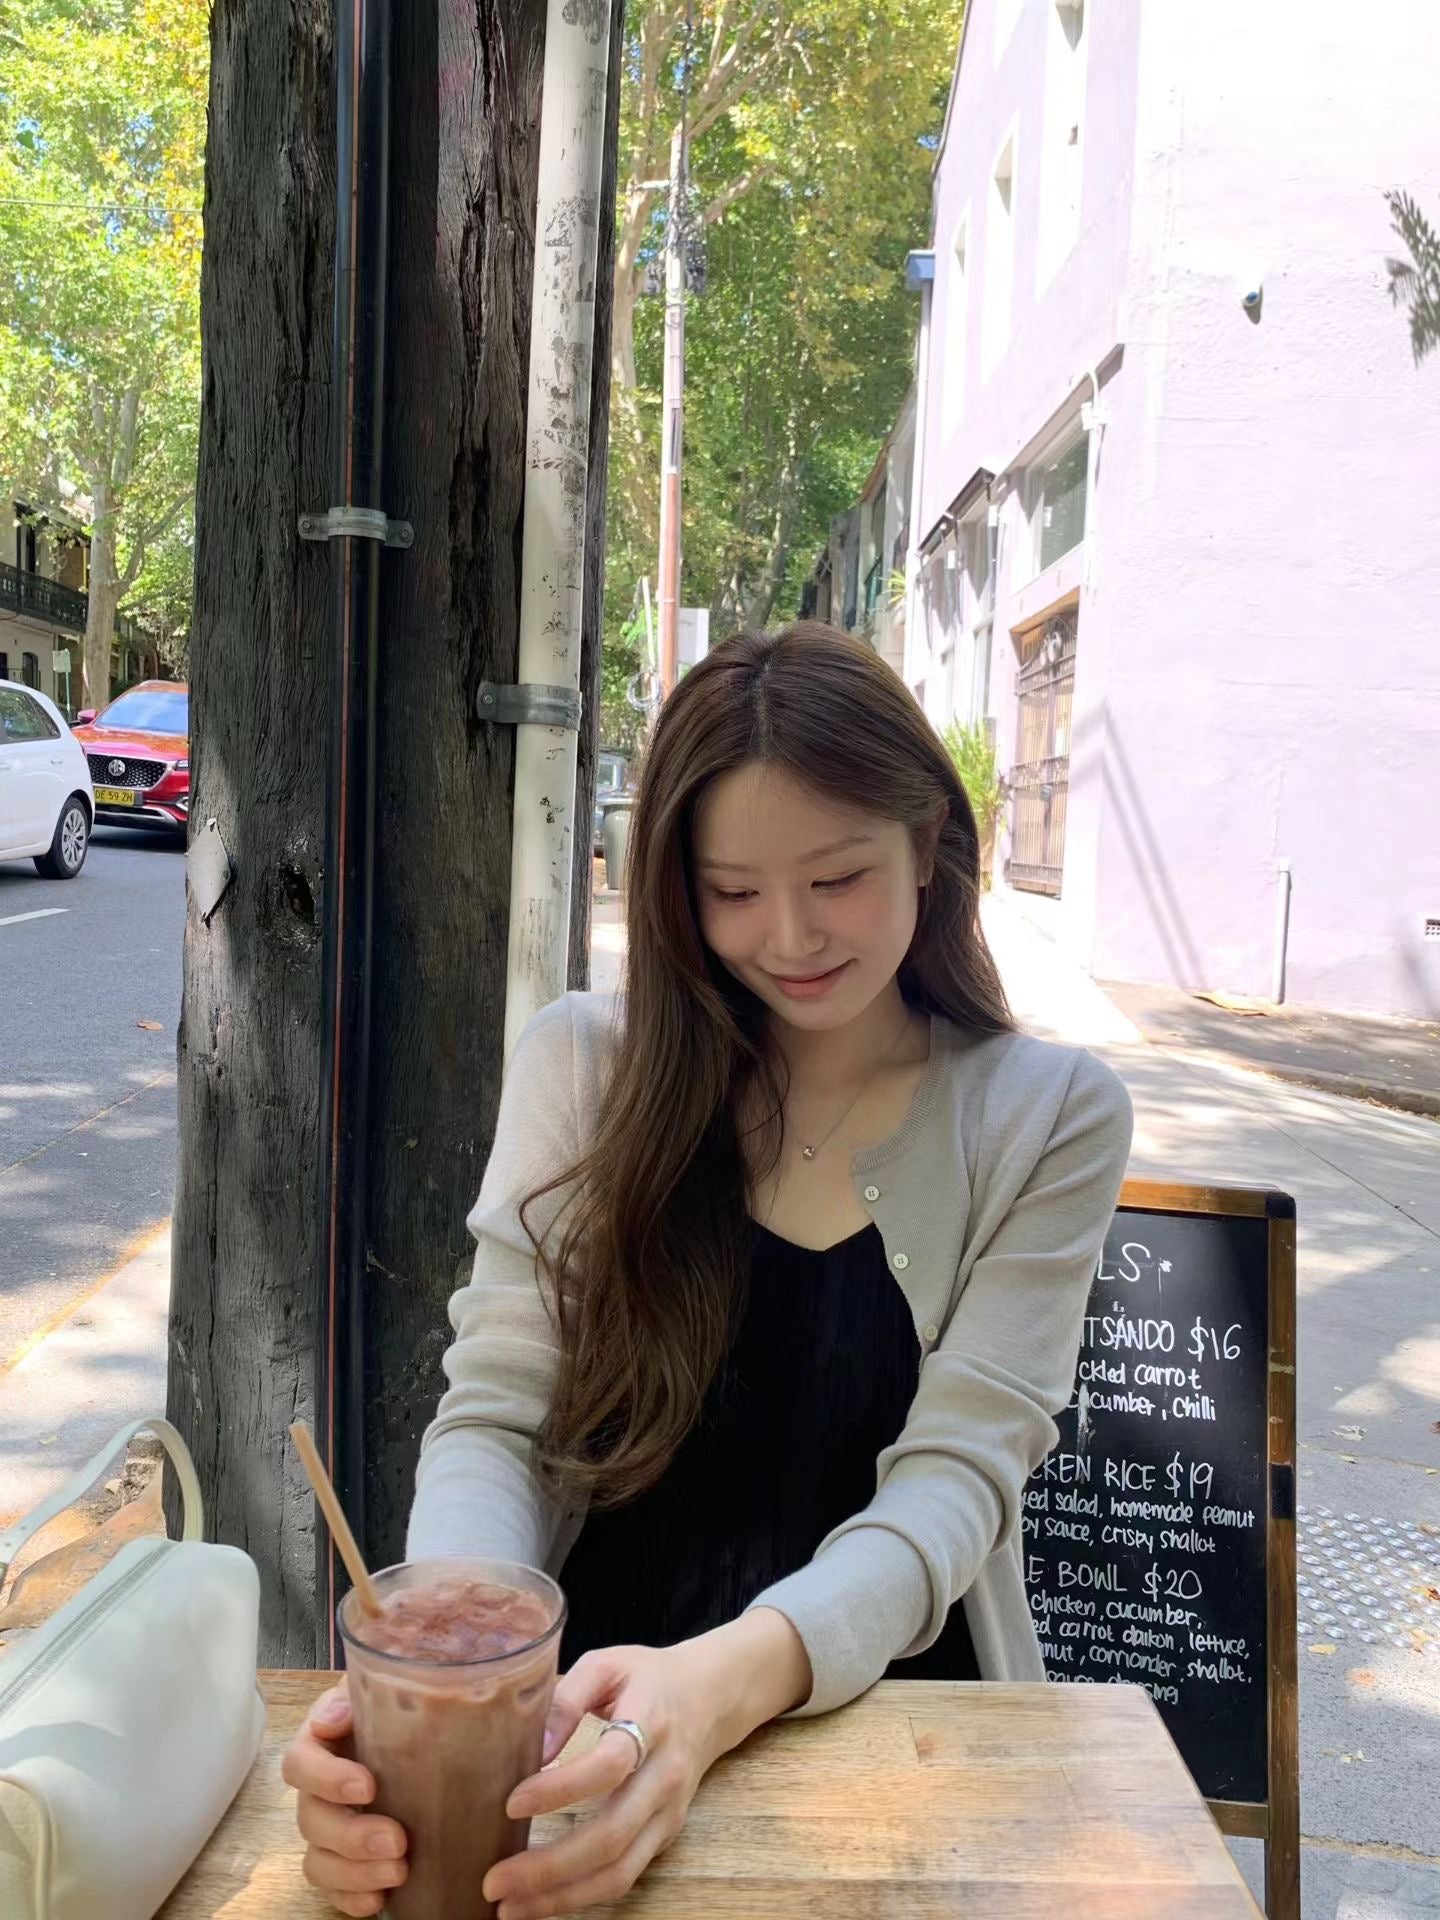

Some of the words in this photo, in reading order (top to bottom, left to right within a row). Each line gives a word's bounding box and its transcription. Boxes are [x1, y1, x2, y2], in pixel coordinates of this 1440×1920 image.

[96, 789, 106, 800] DE
[109, 790, 119, 801] 59
[1187, 1316, 1242, 1362] $16
[1104, 1457, 1156, 1491] RICE
[1164, 1451, 1214, 1500] $19
[1055, 1488, 1104, 1519] salad,
[1110, 1497, 1194, 1524] homemade
[1202, 1505, 1255, 1529] peanut
[1044, 1517, 1094, 1547] sauce,
[1101, 1524, 1154, 1555] crispy
[1160, 1528, 1216, 1555] shallot
[1057, 1560, 1128, 1593] BOWL
[1142, 1561, 1203, 1603] $20
[1059, 1621, 1115, 1642] carrot
[1189, 1631, 1251, 1660] lettuce,
[1186, 1657, 1252, 1684] shallot,
